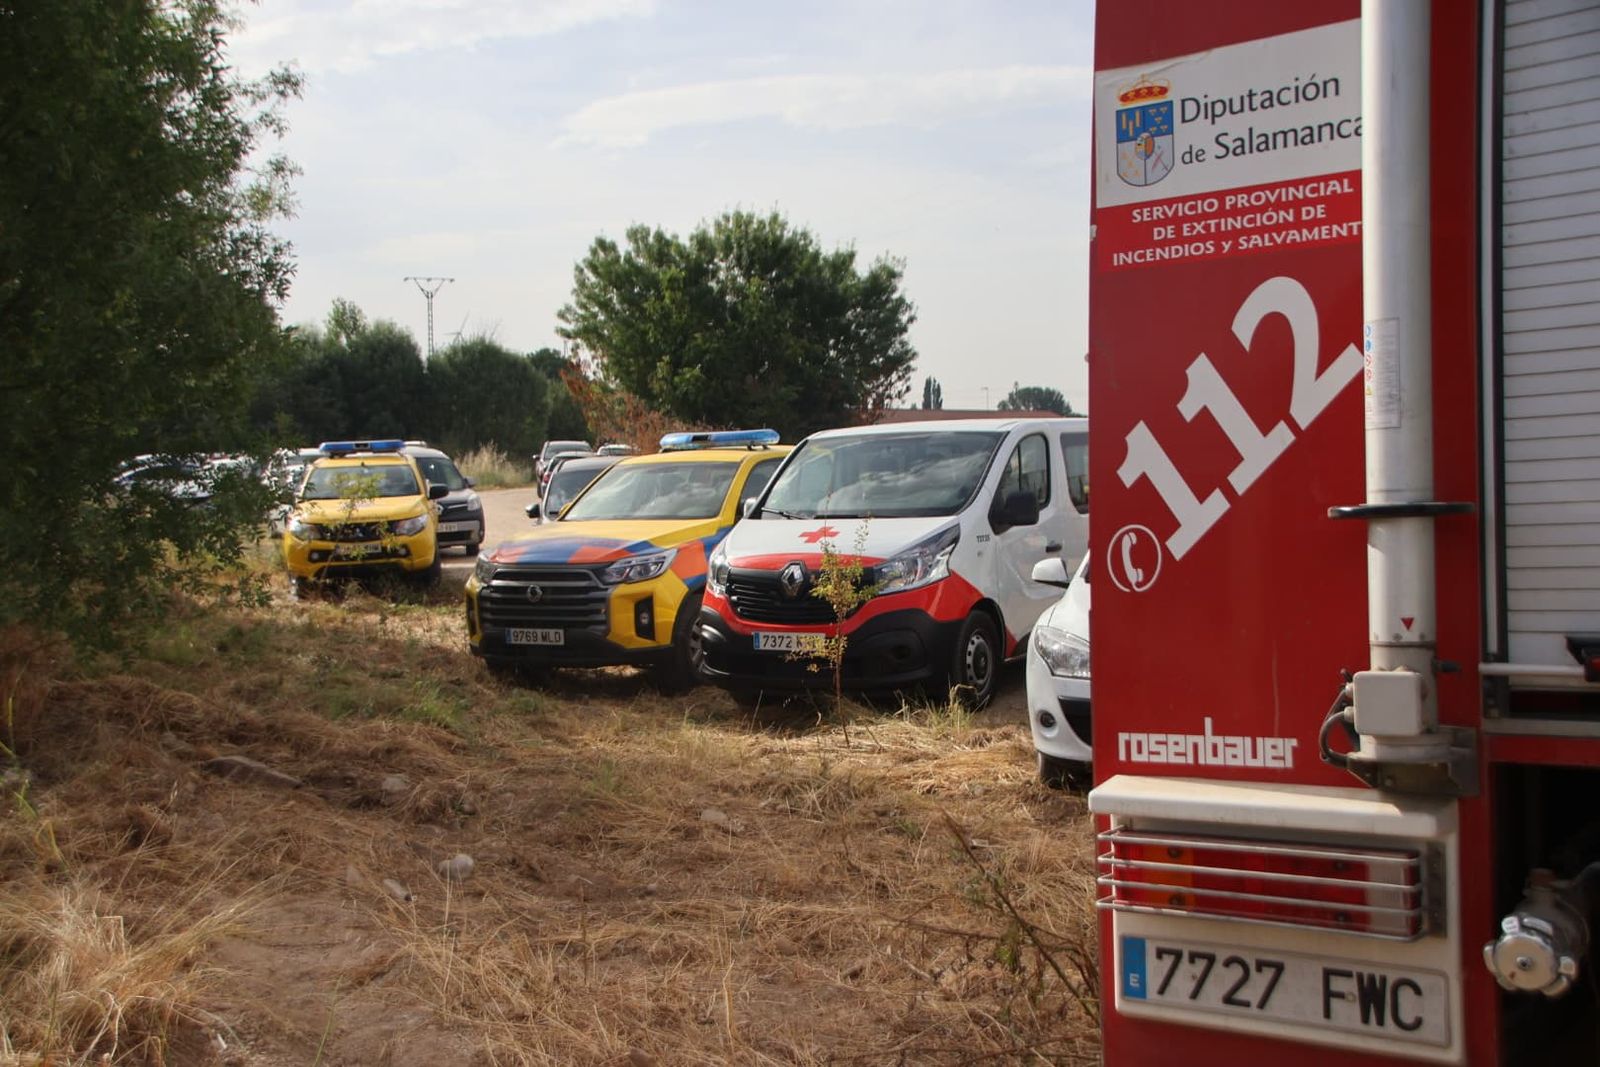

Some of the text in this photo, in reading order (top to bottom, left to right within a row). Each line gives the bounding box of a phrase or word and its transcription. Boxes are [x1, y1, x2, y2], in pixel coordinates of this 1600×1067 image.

[1180, 73, 1340, 125] Diputación
[1181, 144, 1206, 165] de
[1131, 178, 1354, 223] SERVICIO PROVINCIAL
[1153, 204, 1326, 241] DE EXTINCIÓN DE
[1113, 221, 1362, 266] INCENDIOS y SALVAMENT
[1116, 276, 1364, 562] 112
[512, 630, 538, 642] 9769
[762, 634, 793, 649] 7372
[1117, 716, 1298, 769] rosenbauer
[1129, 946, 1423, 1032] E 7727 FWC
